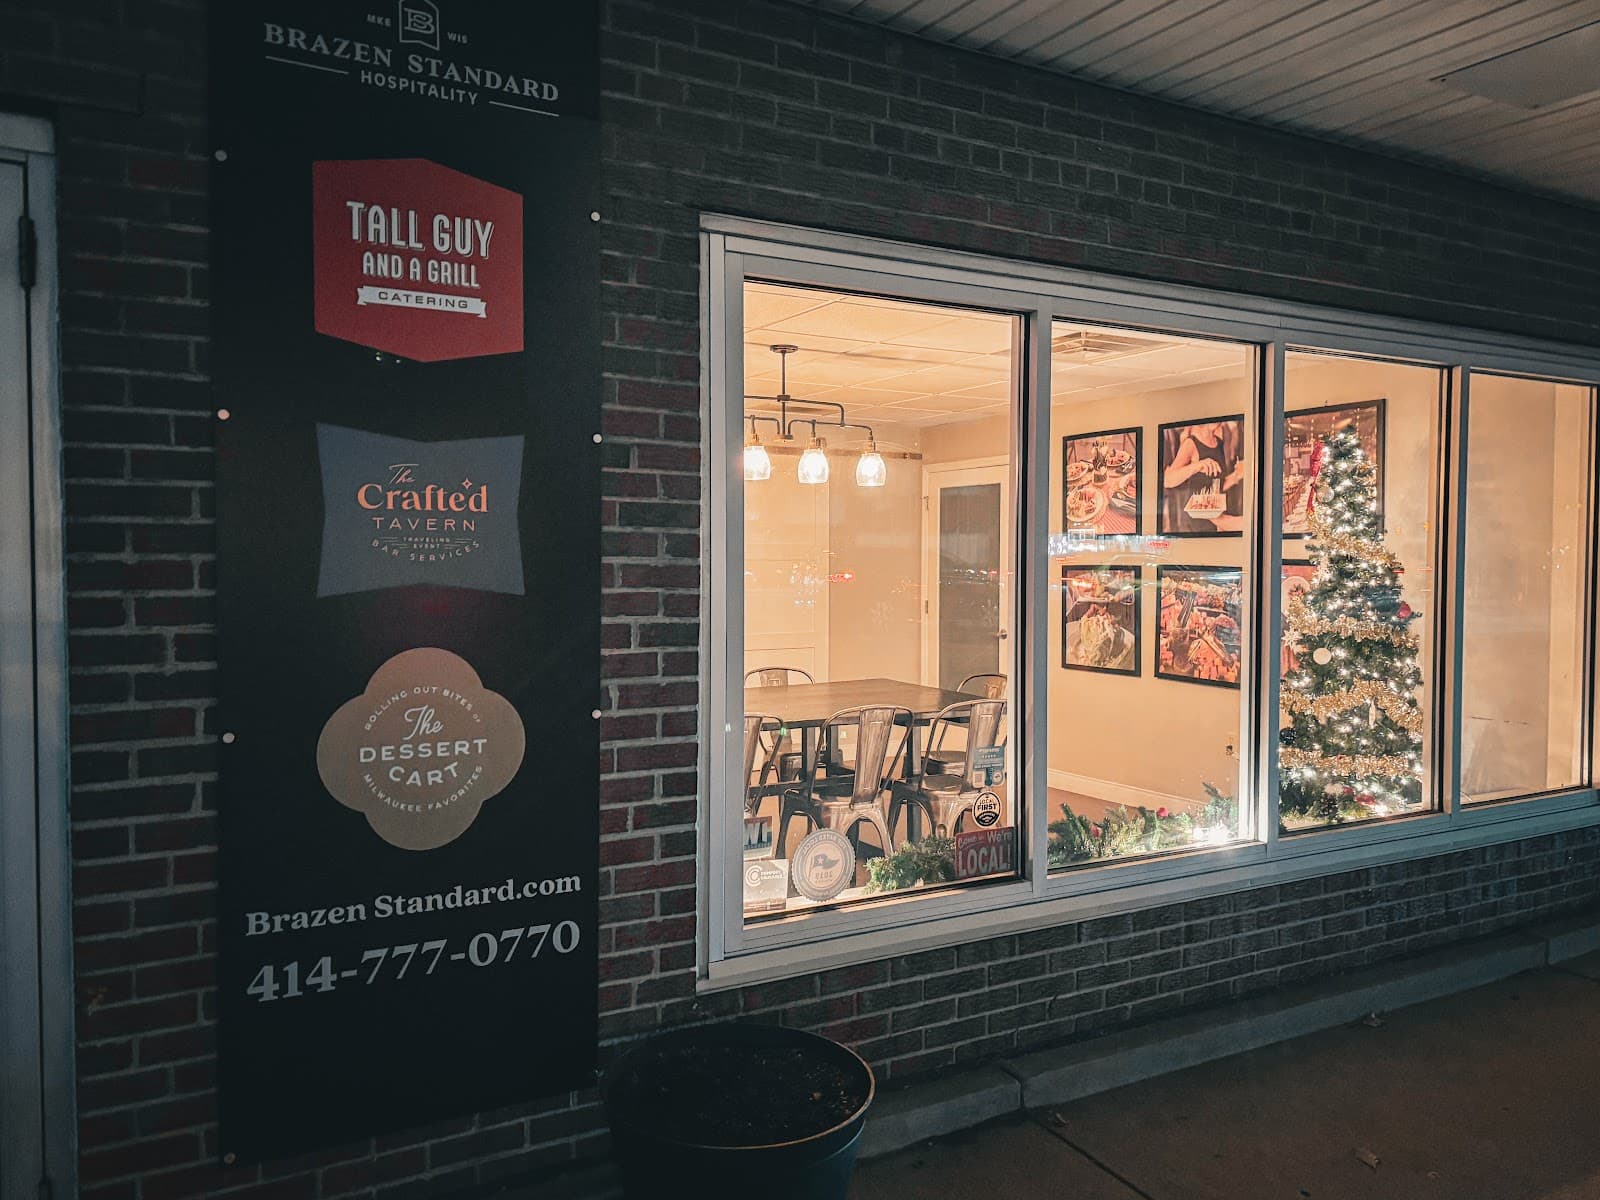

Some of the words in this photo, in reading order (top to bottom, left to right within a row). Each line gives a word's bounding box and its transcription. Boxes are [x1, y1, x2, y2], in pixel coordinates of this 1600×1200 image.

[264, 22, 393, 67] BRAZEN
[407, 54, 559, 101] STANDARD
[360, 70, 478, 105] HOSPITALITY
[346, 201, 425, 250] TALL
[432, 213, 494, 259] GUY
[362, 251, 404, 280] AND
[409, 257, 422, 281] A
[427, 259, 480, 289] GRILL
[378, 290, 469, 310] CATERING
[389, 463, 420, 484] The
[356, 483, 488, 512] Crafted
[372, 517, 476, 532] TAVERN
[372, 538, 400, 557] BAR
[409, 540, 480, 561] SERVICES
[364, 690, 408, 731] ROLLING
[413, 686, 438, 695] OUT
[442, 688, 473, 711] BITES
[402, 704, 444, 740] The
[359, 738, 487, 763] DESSERT
[363, 773, 422, 812] MILWAUKEE
[427, 766, 483, 811] FAVORITES
[389, 761, 458, 786] CART
[977, 803, 998, 811] FIRST
[959, 844, 1011, 877] LOCAL!
[246, 903, 367, 936] Brazen
[374, 875, 581, 918] Standard.com
[246, 920, 580, 1002] 414-777-0770
